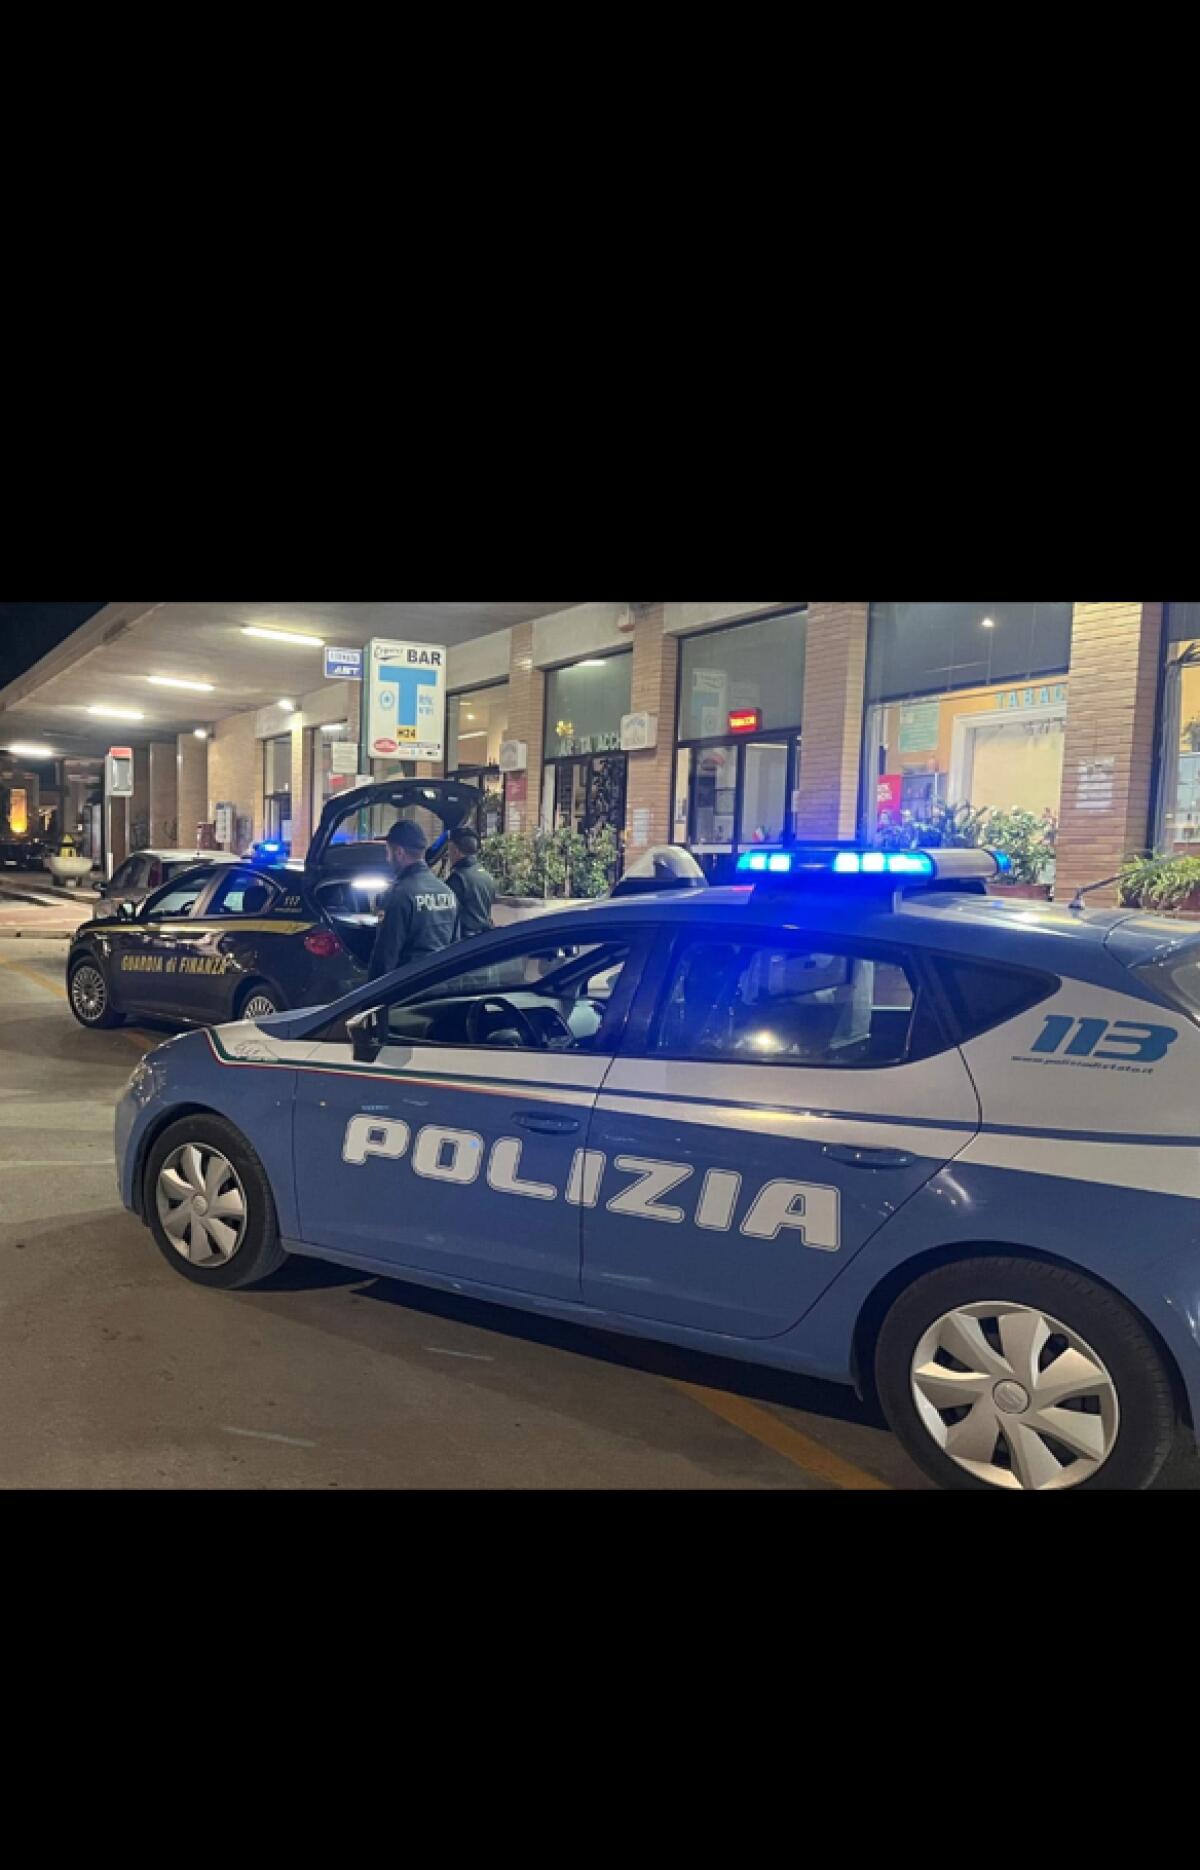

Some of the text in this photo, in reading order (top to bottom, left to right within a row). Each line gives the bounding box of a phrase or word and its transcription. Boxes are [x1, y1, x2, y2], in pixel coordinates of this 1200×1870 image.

[406, 648, 441, 666] BAR
[378, 666, 437, 726] T
[121, 954, 226, 975] GUARDIA di FINANZA
[1030, 1014, 1178, 1063] 113
[342, 1113, 841, 1253] POLIZIA
